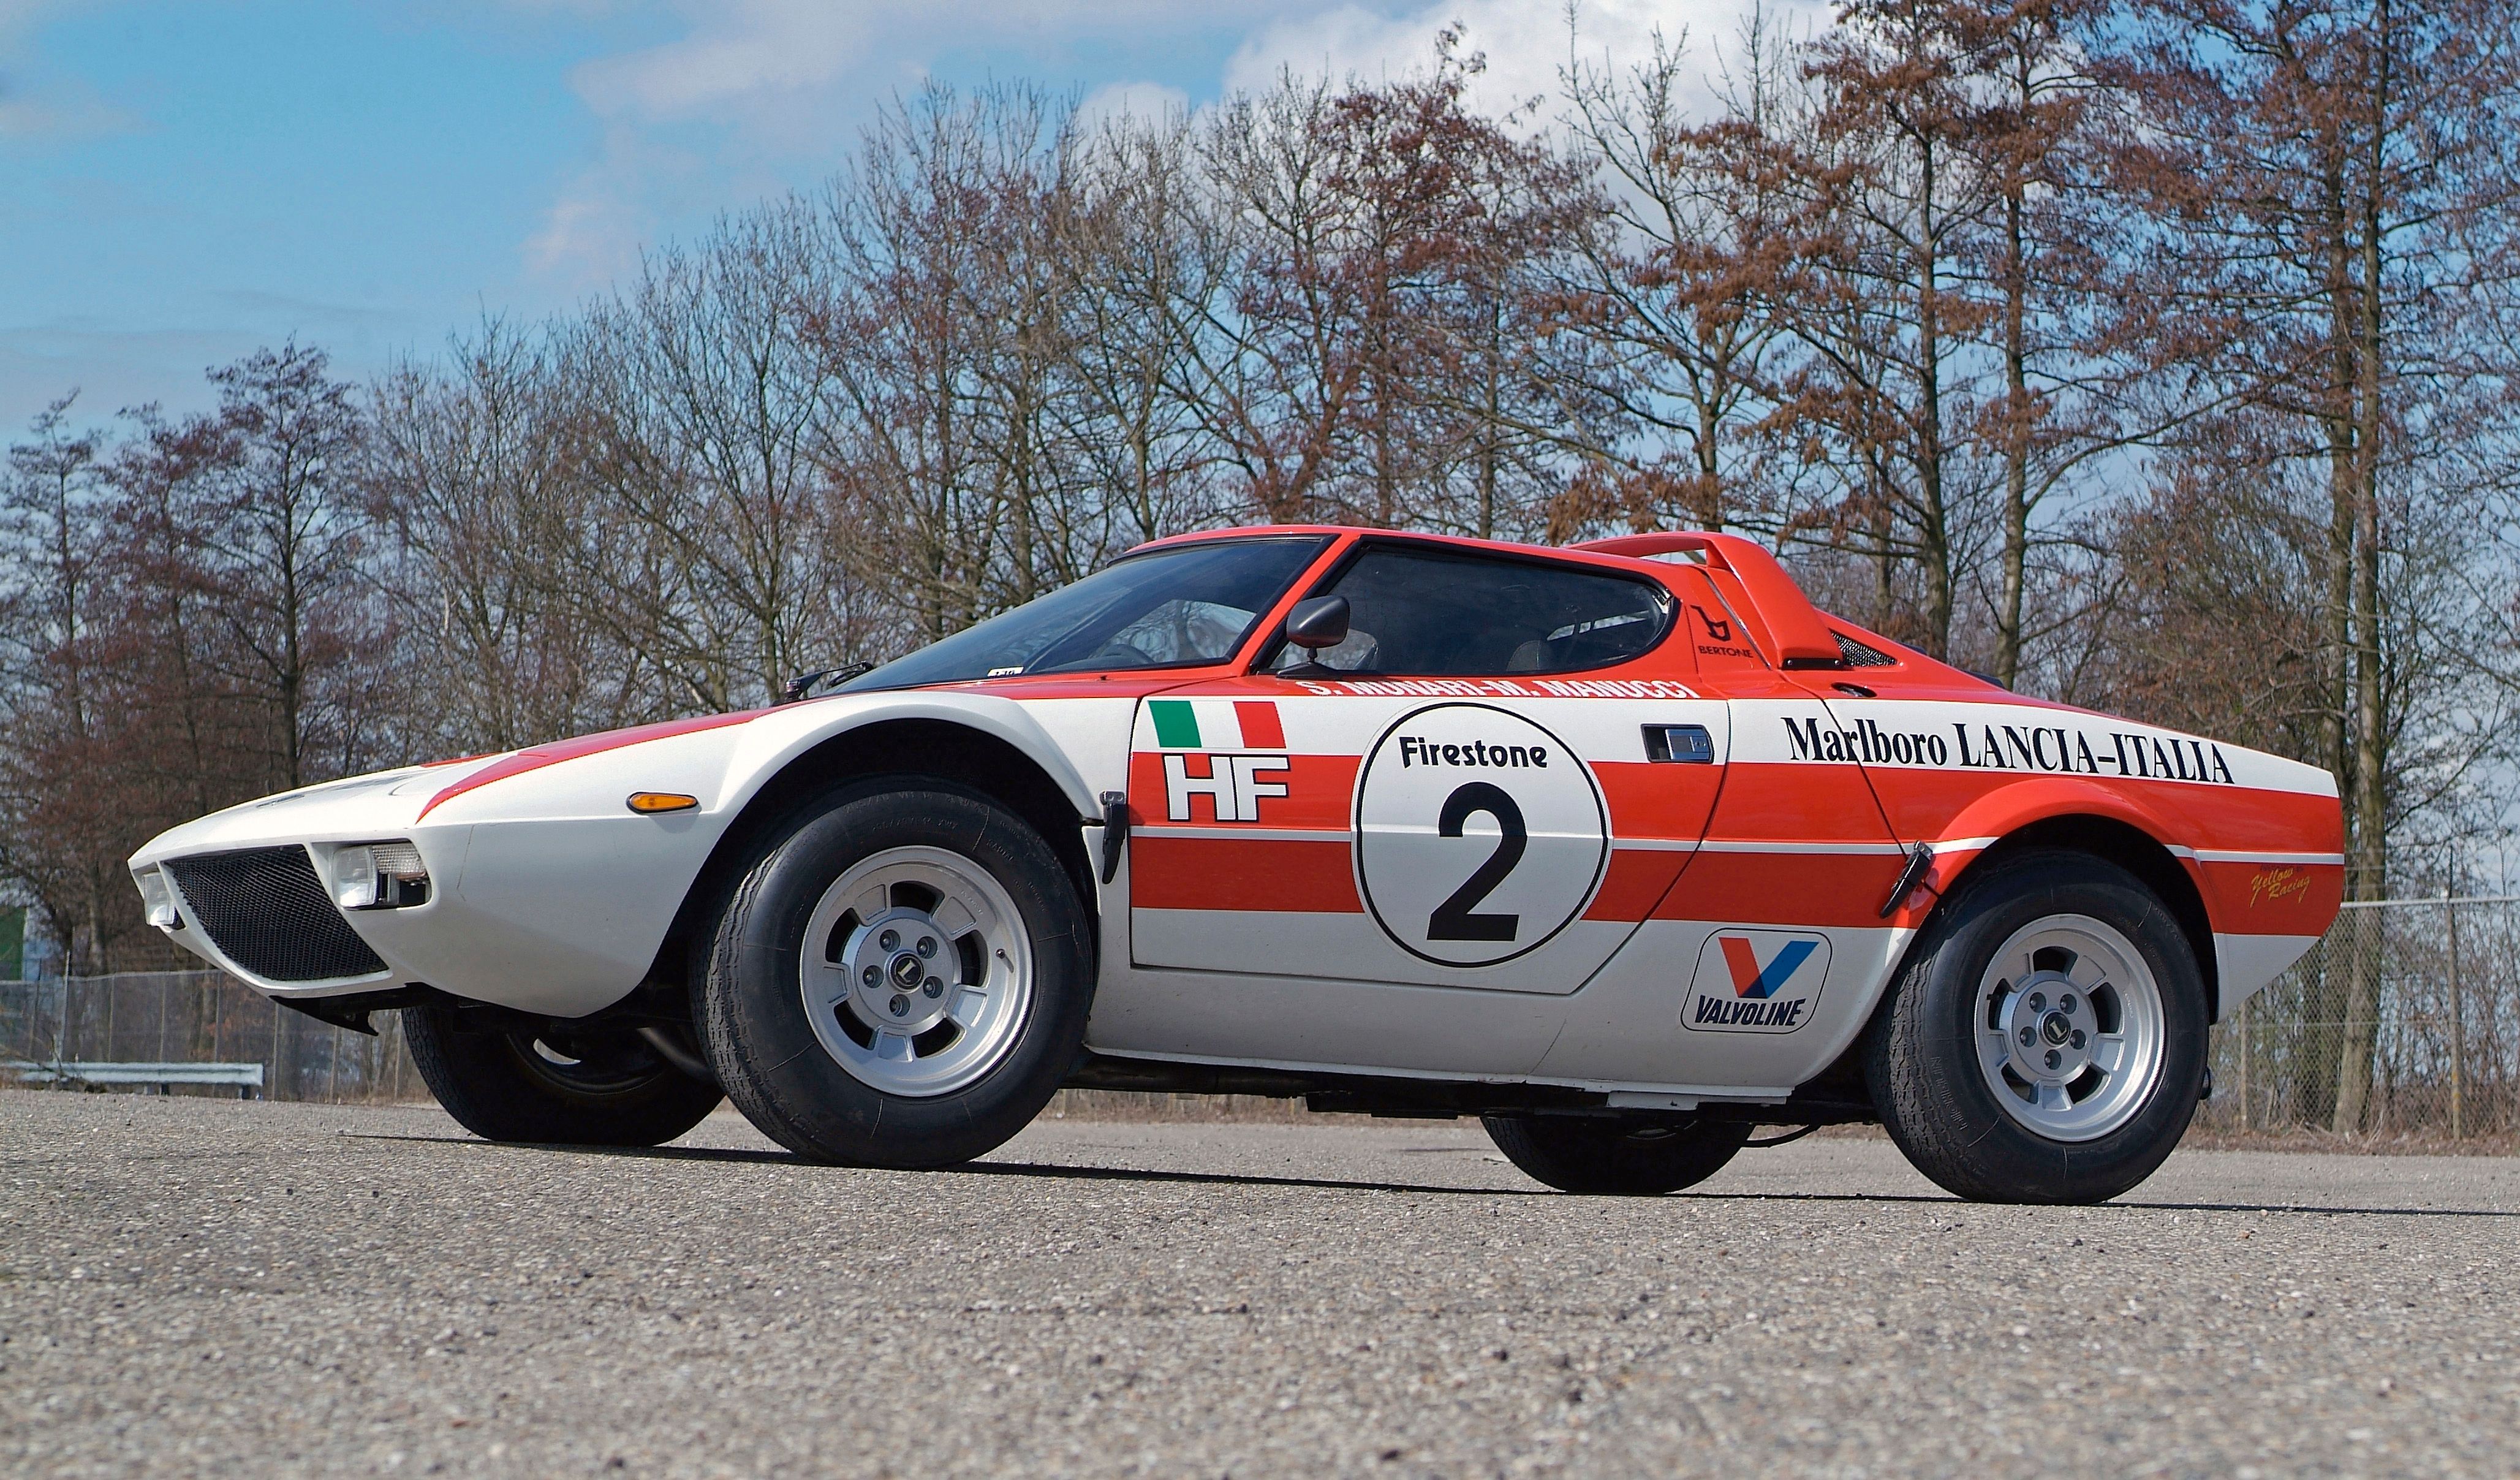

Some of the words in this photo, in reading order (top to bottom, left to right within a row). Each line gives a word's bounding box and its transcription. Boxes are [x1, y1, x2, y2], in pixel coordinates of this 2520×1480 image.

[1698, 645, 1754, 658] BERTONE
[1295, 681, 1343, 696] S.
[1531, 680, 1701, 699] MANUCCI
[1399, 737, 1548, 768] Firestone
[1780, 716, 1948, 766] Marlboro
[1953, 723, 2235, 784] LANCIA-ITALIA
[1162, 754, 1290, 821] HF
[1426, 781, 1527, 941] 2
[2249, 868, 2293, 908] Yellow
[2268, 876, 2310, 903] Racing
[1695, 995, 1806, 1027] VALVOLINE
[2049, 1019, 2067, 1039] L
